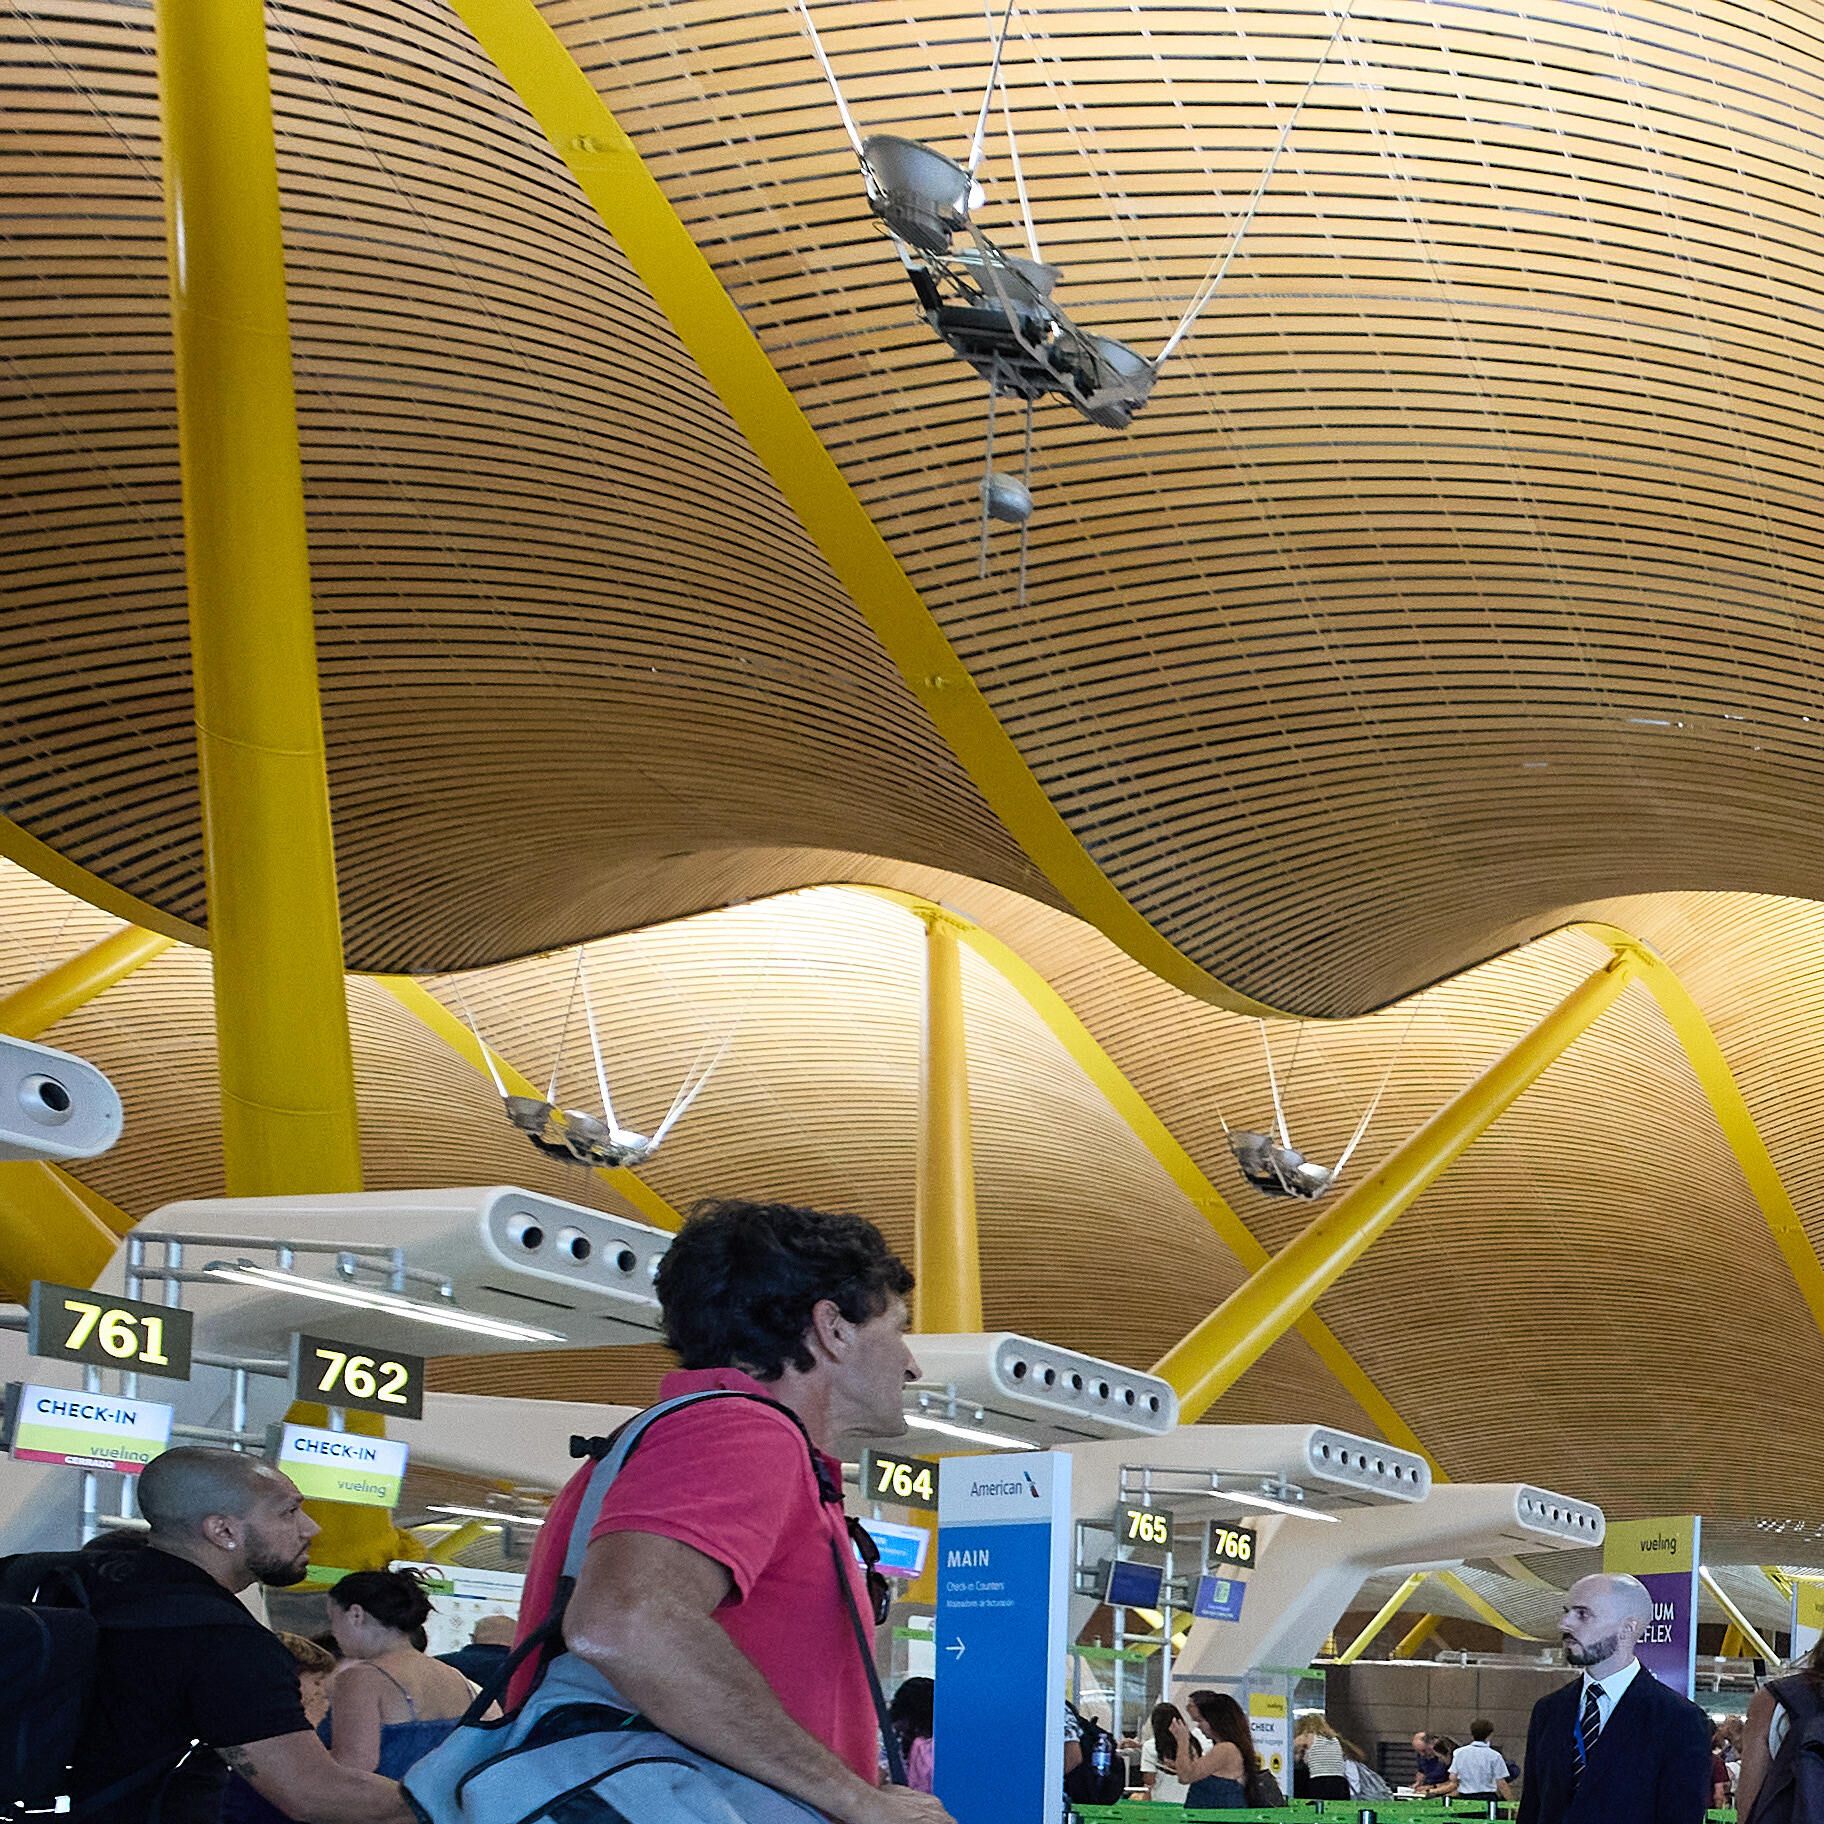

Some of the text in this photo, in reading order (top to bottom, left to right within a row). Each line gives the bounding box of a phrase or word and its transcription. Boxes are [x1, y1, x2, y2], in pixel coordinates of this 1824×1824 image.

[63, 1299, 169, 1367] 761
[315, 1348, 409, 1405] 762
[36, 1398, 137, 1426] CHECK-IN
[294, 1437, 377, 1461] CHECK-IN
[337, 1478, 388, 1498] vueling
[876, 1459, 934, 1501] 764
[970, 1480, 1023, 1497] American
[1127, 1510, 1168, 1545] 765
[1215, 1529, 1251, 1561] 766
[1640, 1533, 1677, 1554] vueling
[947, 1549, 990, 1568] MAIN
